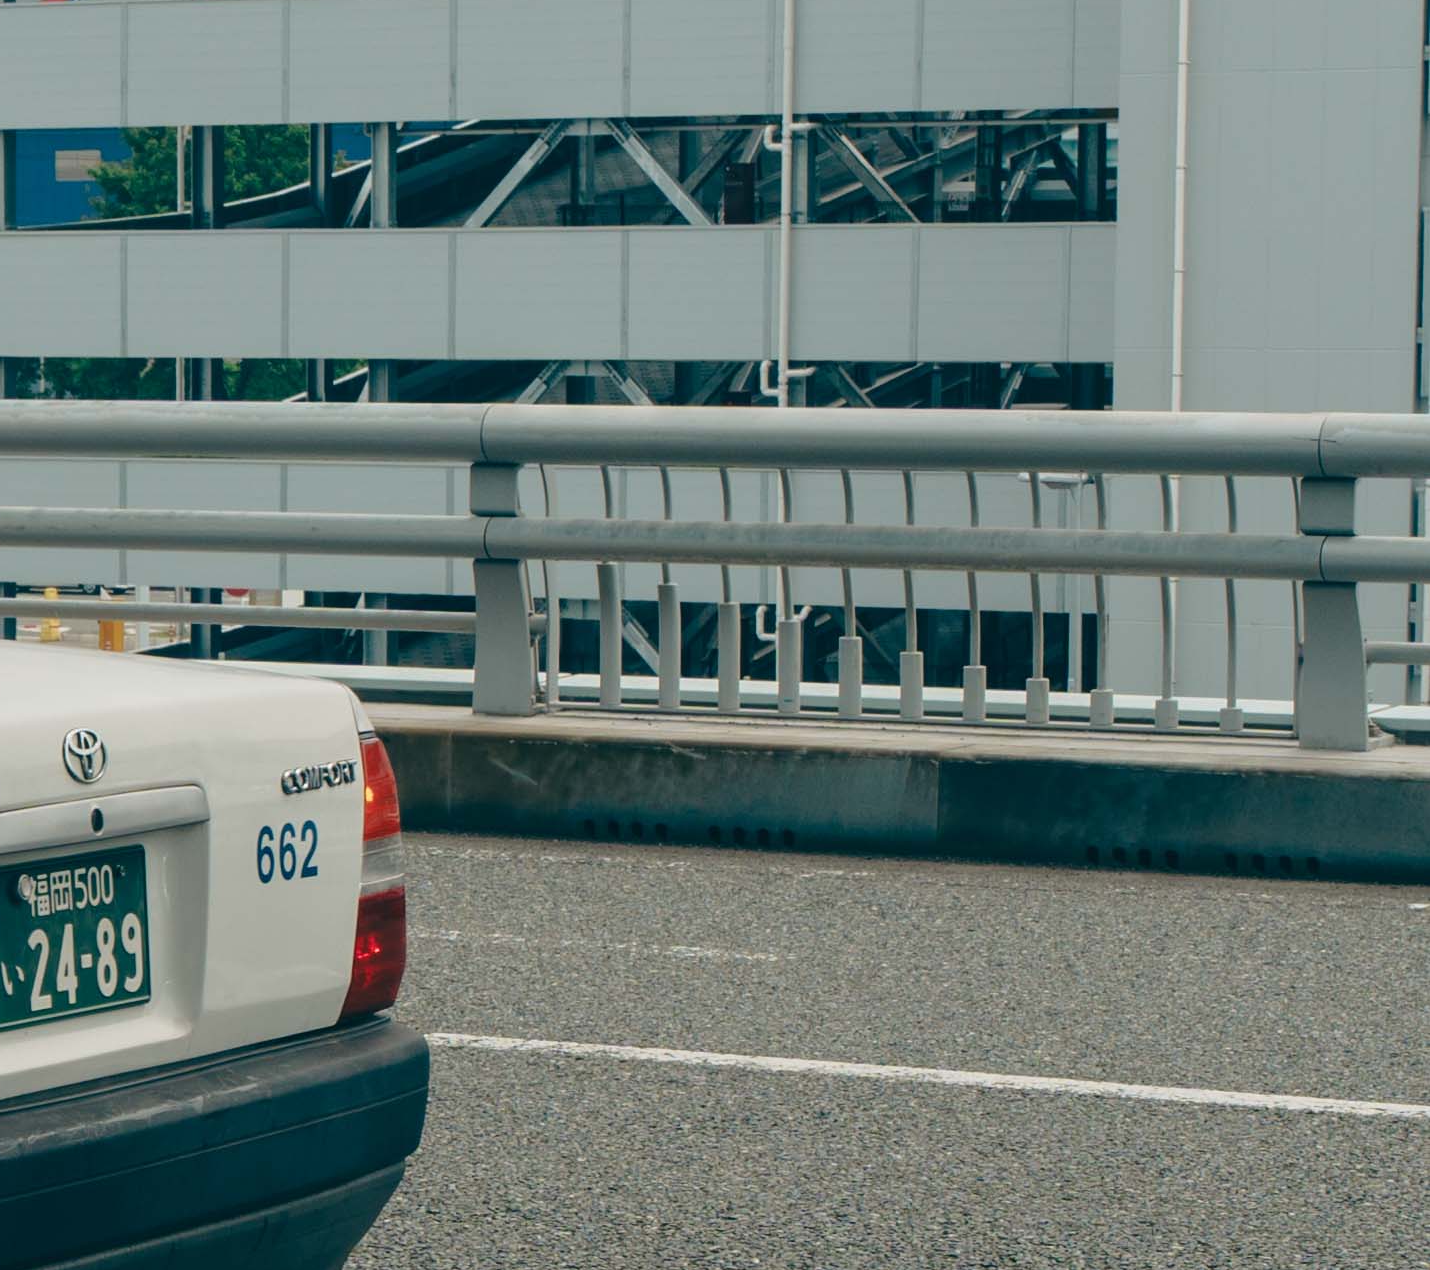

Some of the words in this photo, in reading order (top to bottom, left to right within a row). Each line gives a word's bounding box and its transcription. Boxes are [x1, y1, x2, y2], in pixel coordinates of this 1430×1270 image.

[280, 759, 358, 797] COMFORT
[256, 819, 319, 885] 662
[27, 912, 145, 1012] 24-89
